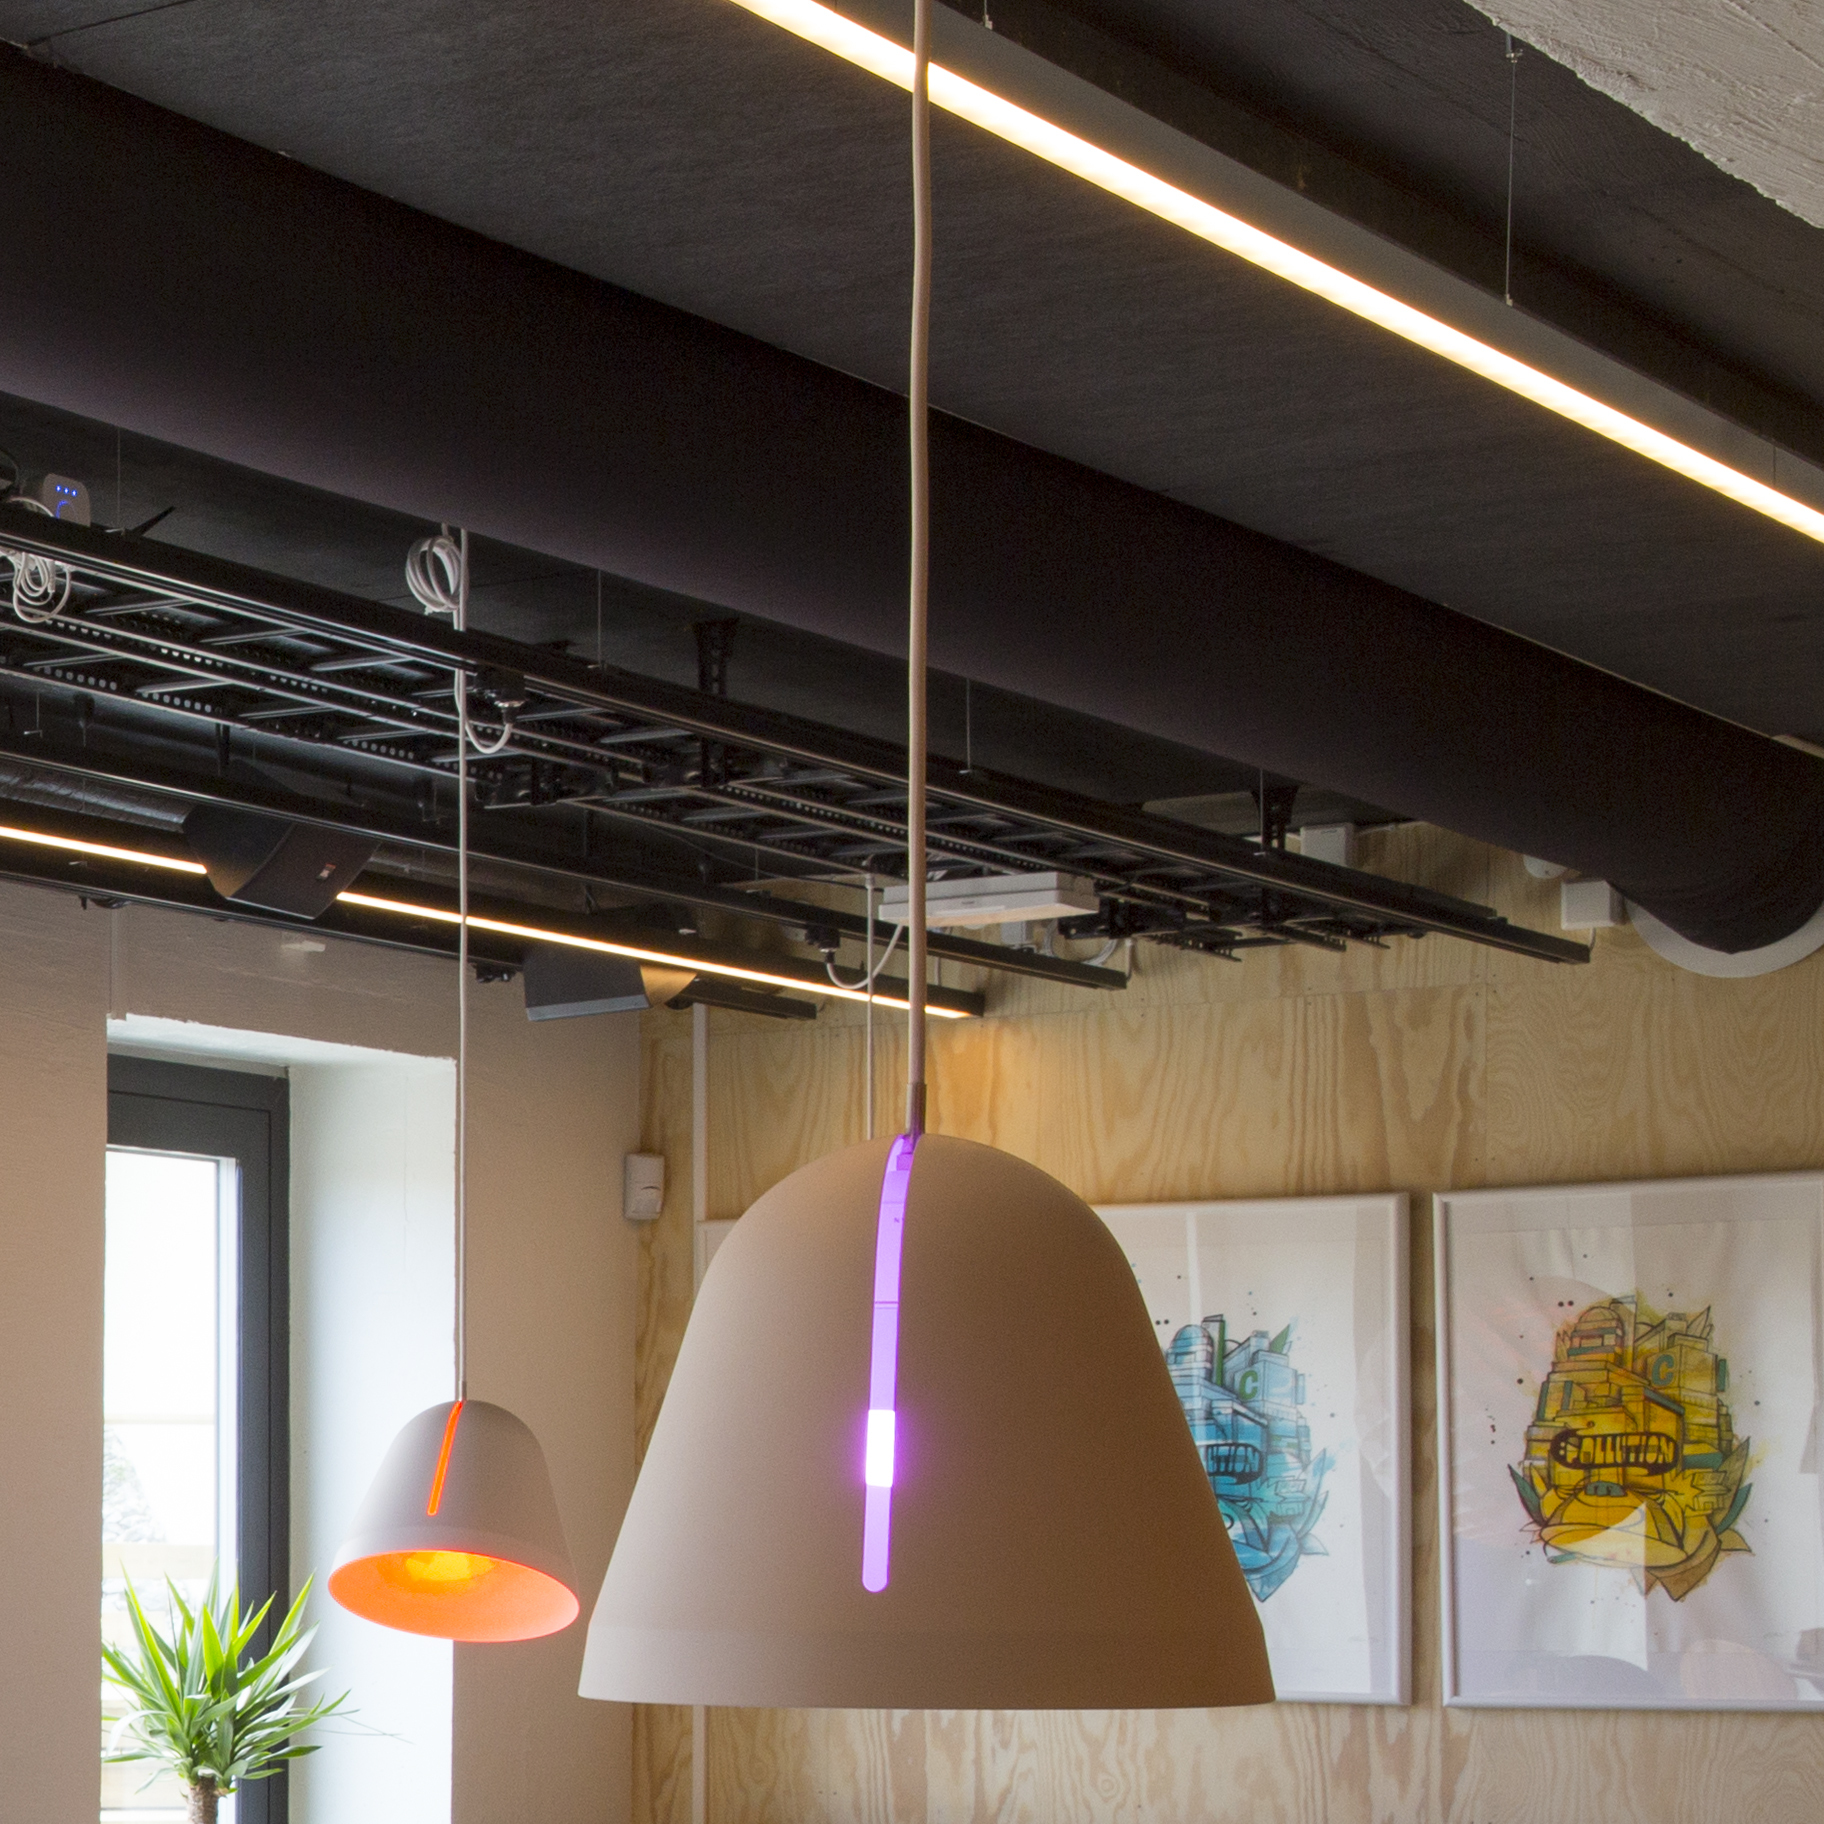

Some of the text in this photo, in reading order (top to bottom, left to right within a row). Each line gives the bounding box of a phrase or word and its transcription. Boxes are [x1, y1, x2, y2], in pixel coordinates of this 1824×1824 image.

[1239, 1369, 1259, 1400] C
[1651, 1353, 1675, 1387] C
[1564, 1434, 1675, 1466] POLLUTION
